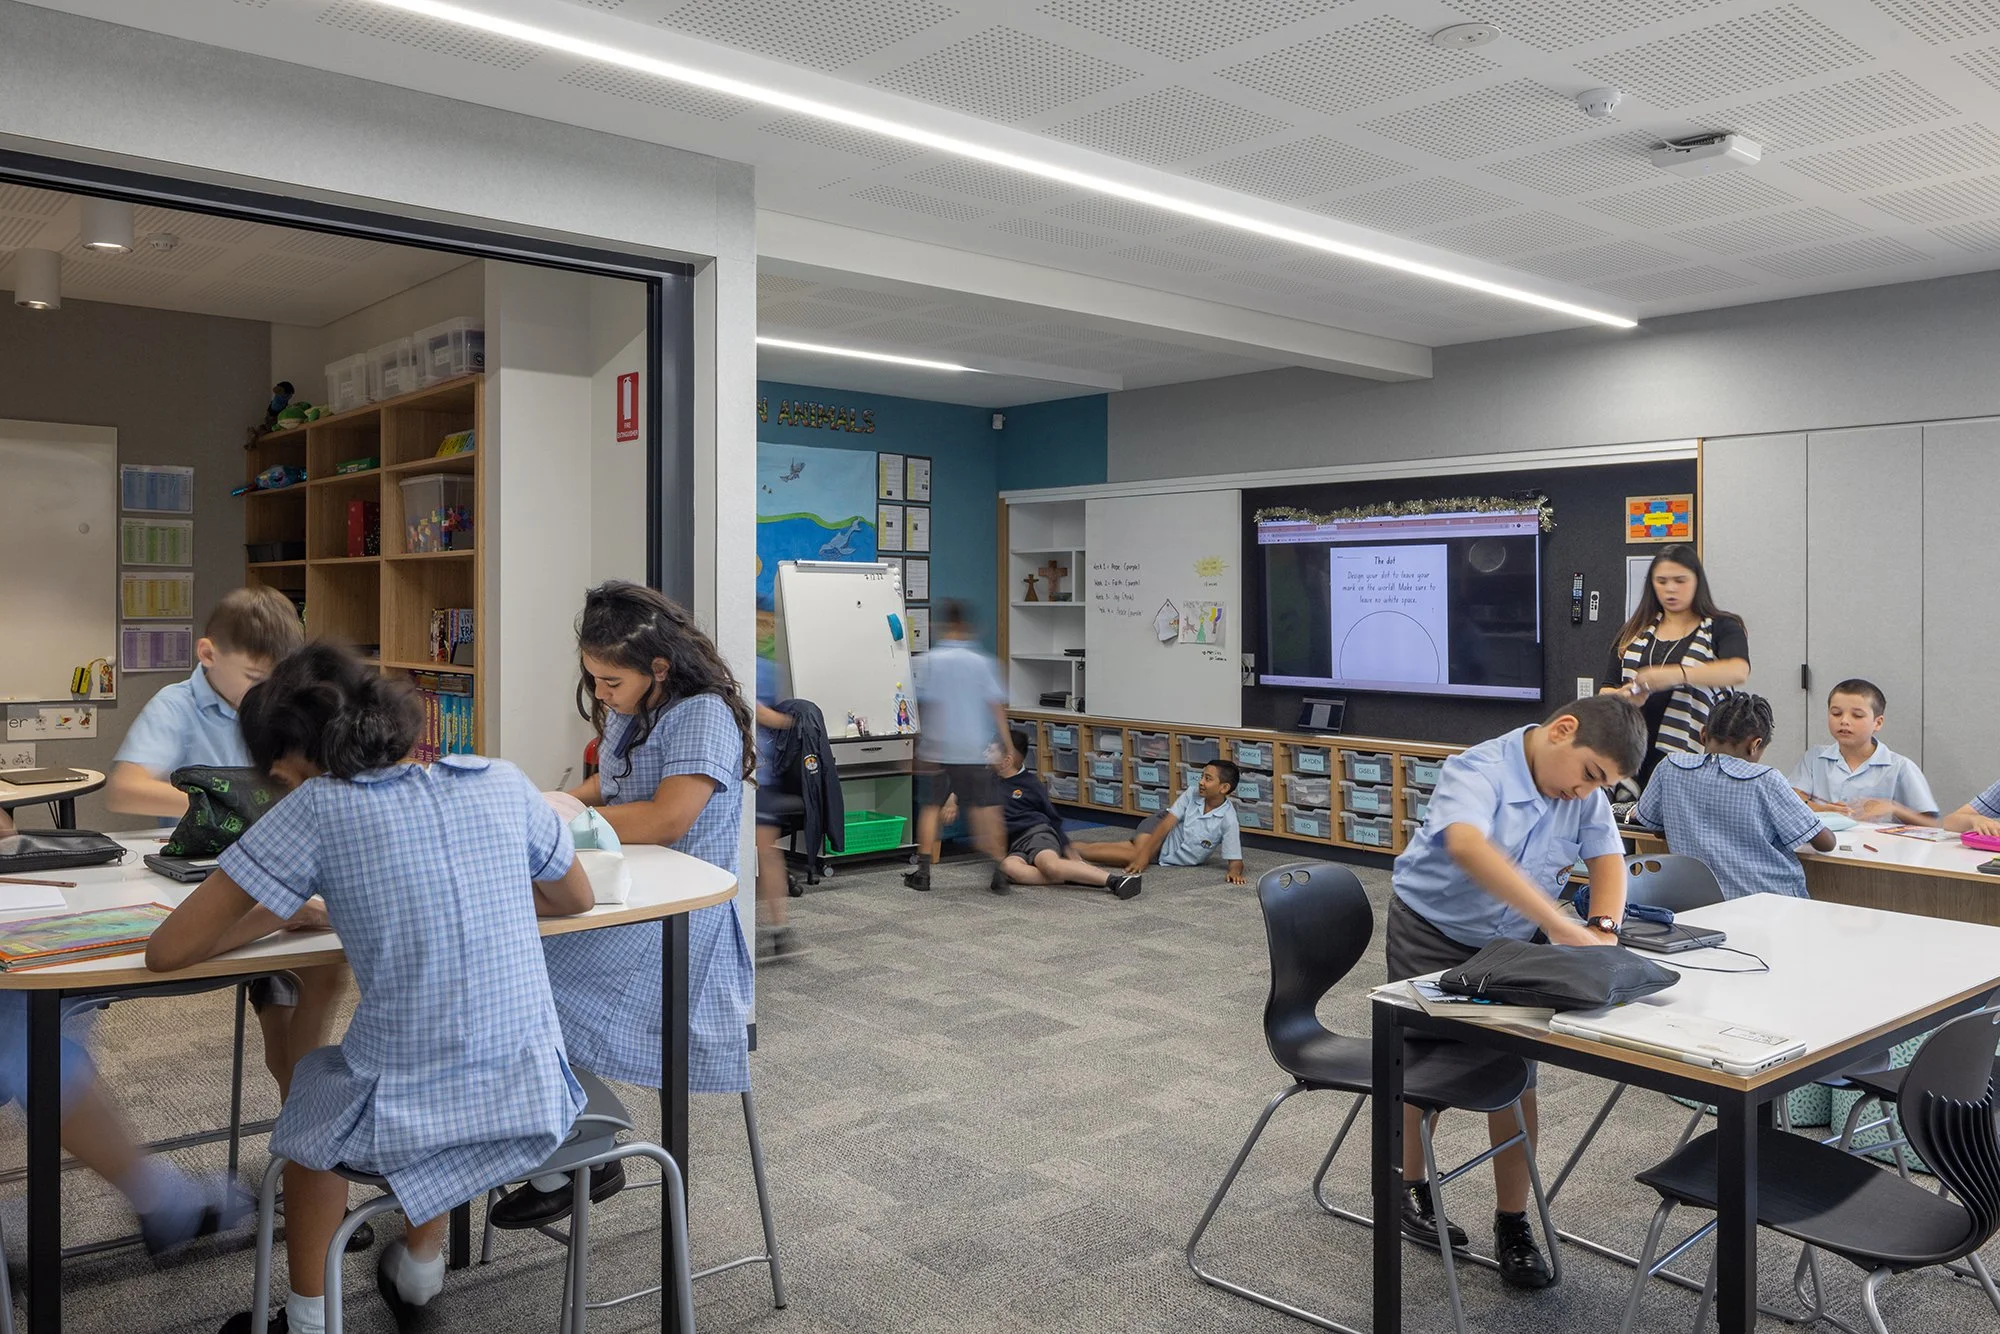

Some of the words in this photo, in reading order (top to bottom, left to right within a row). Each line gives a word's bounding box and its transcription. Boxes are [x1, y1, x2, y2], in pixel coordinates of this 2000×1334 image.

[777, 400, 876, 434] ANIMALS
[624, 421, 632, 429] FIRE
[616, 429, 638, 439] EXTINGUISHER
[1374, 556, 1384, 564] The
[1386, 556, 1396, 564] dot
[1348, 571, 1364, 582] Design
[1381, 571, 1390, 579] dot
[1417, 573, 1430, 582] your
[1430, 583, 1436, 591] to
[9, 718, 28, 728] er
